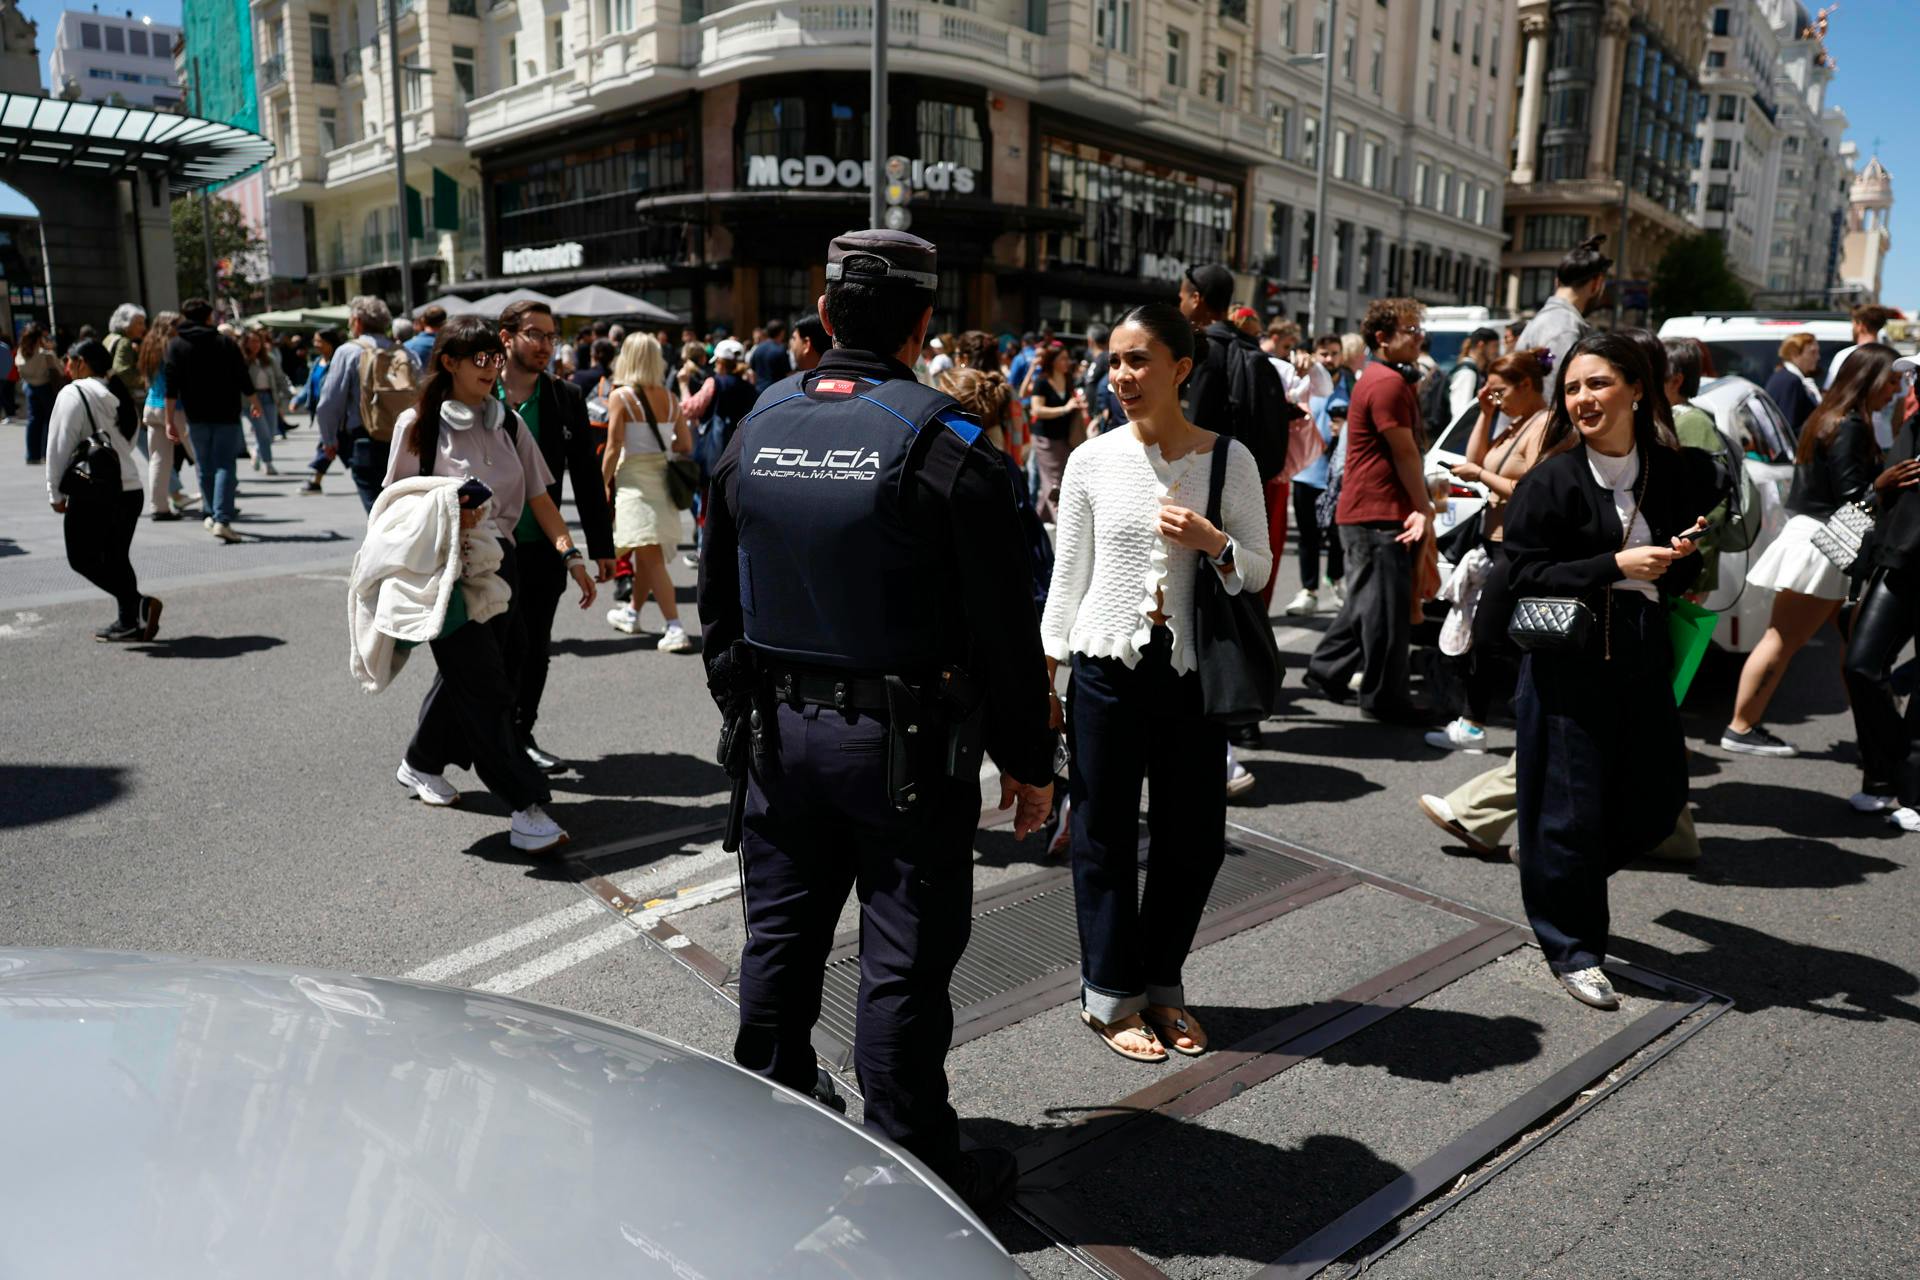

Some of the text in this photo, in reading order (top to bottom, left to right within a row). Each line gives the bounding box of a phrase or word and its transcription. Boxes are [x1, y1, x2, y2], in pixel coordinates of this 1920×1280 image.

[748, 155, 975, 192] McDold's
[753, 447, 880, 469] POLICÍA
[750, 468, 877, 481] MUNICIPAL MADRID
